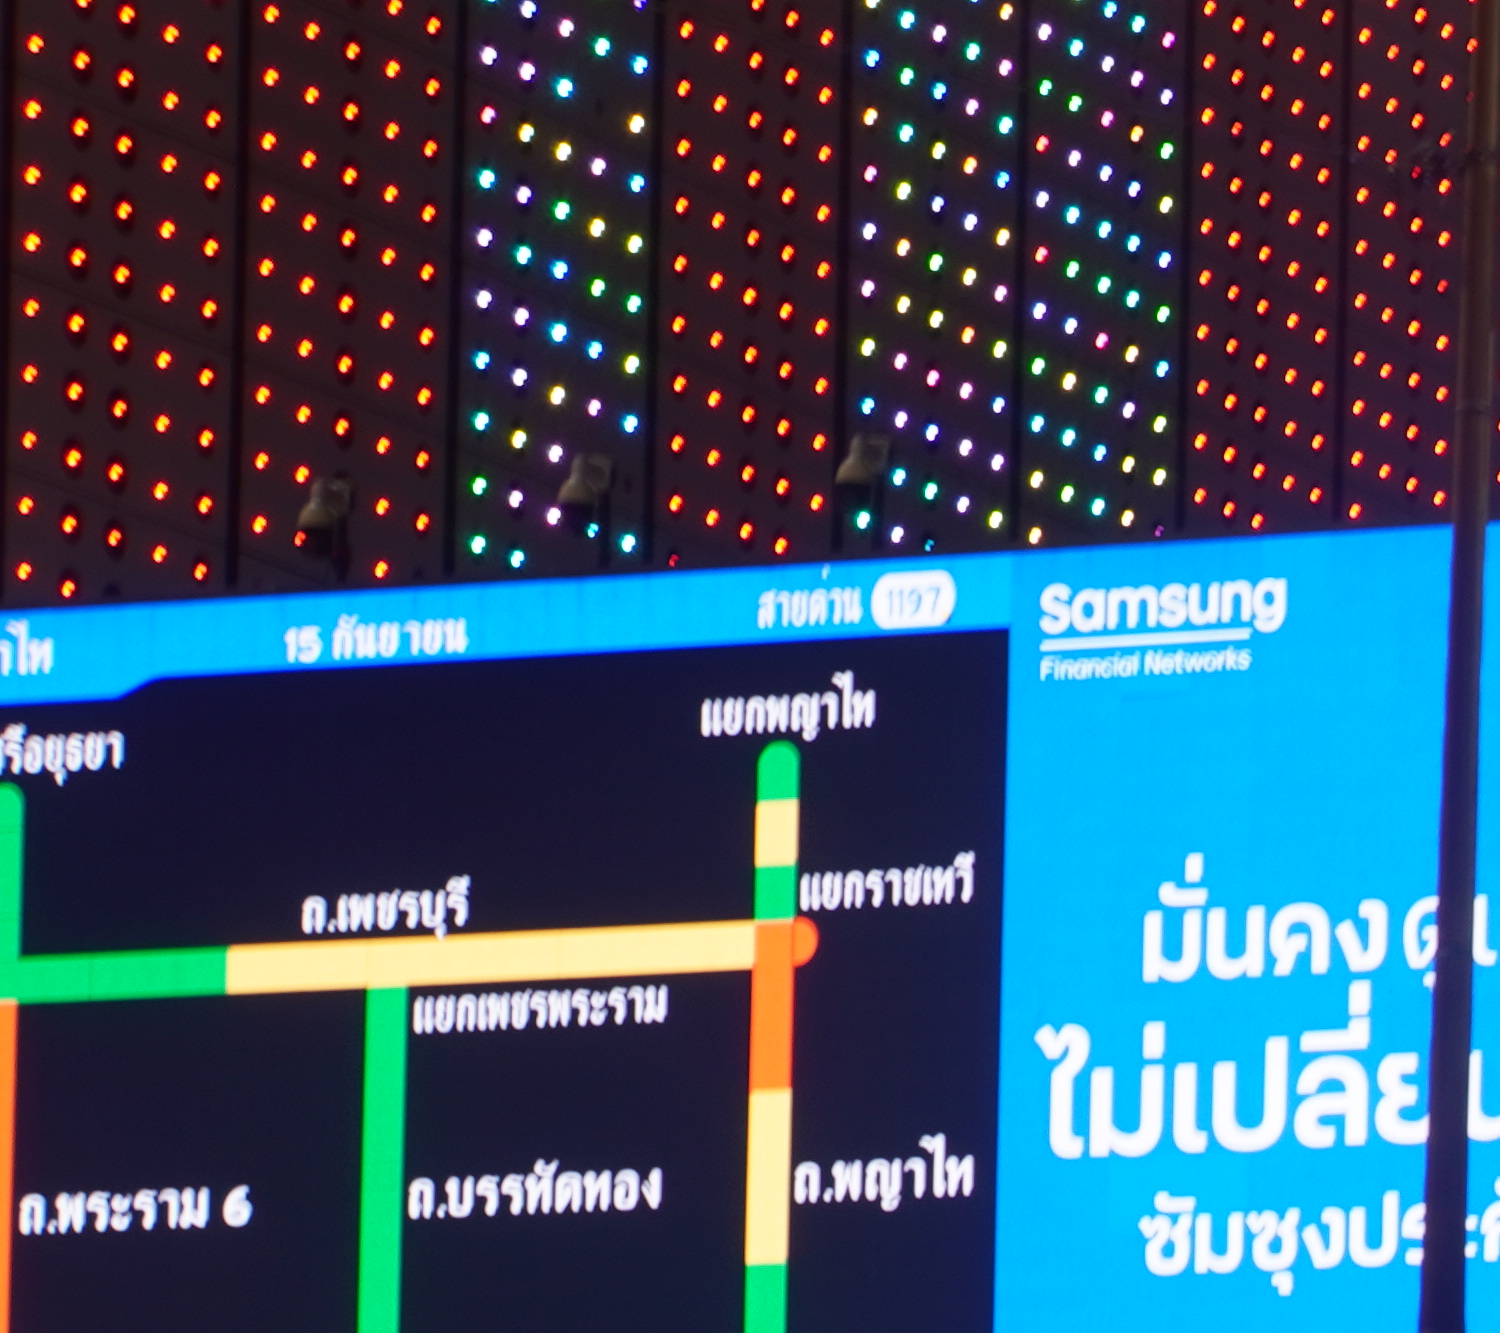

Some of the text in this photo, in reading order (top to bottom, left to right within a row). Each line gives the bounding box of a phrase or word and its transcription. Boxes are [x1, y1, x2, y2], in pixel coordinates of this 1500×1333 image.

[882, 582, 945, 619] 1197
[1039, 575, 1289, 636] Samsung
[284, 614, 469, 664] 15 กันยายน
[1039, 645, 1253, 682] Financial Networks
[699, 670, 877, 741] แยกพญาไท
[0, 721, 126, 787] รีอยุธยา
[301, 874, 472, 941] ถ.เพชรบุรี
[799, 850, 977, 914] แยกราชเทวี
[1141, 852, 1389, 984] มั่นคง
[411, 979, 670, 1037] แยกเพชรพระราม
[406, 1158, 664, 1222] ถ.บรรทัดทอง
[791, 1132, 977, 1213] ถ.พญาไท
[17, 1183, 254, 1239] ถ.พระราม 6
